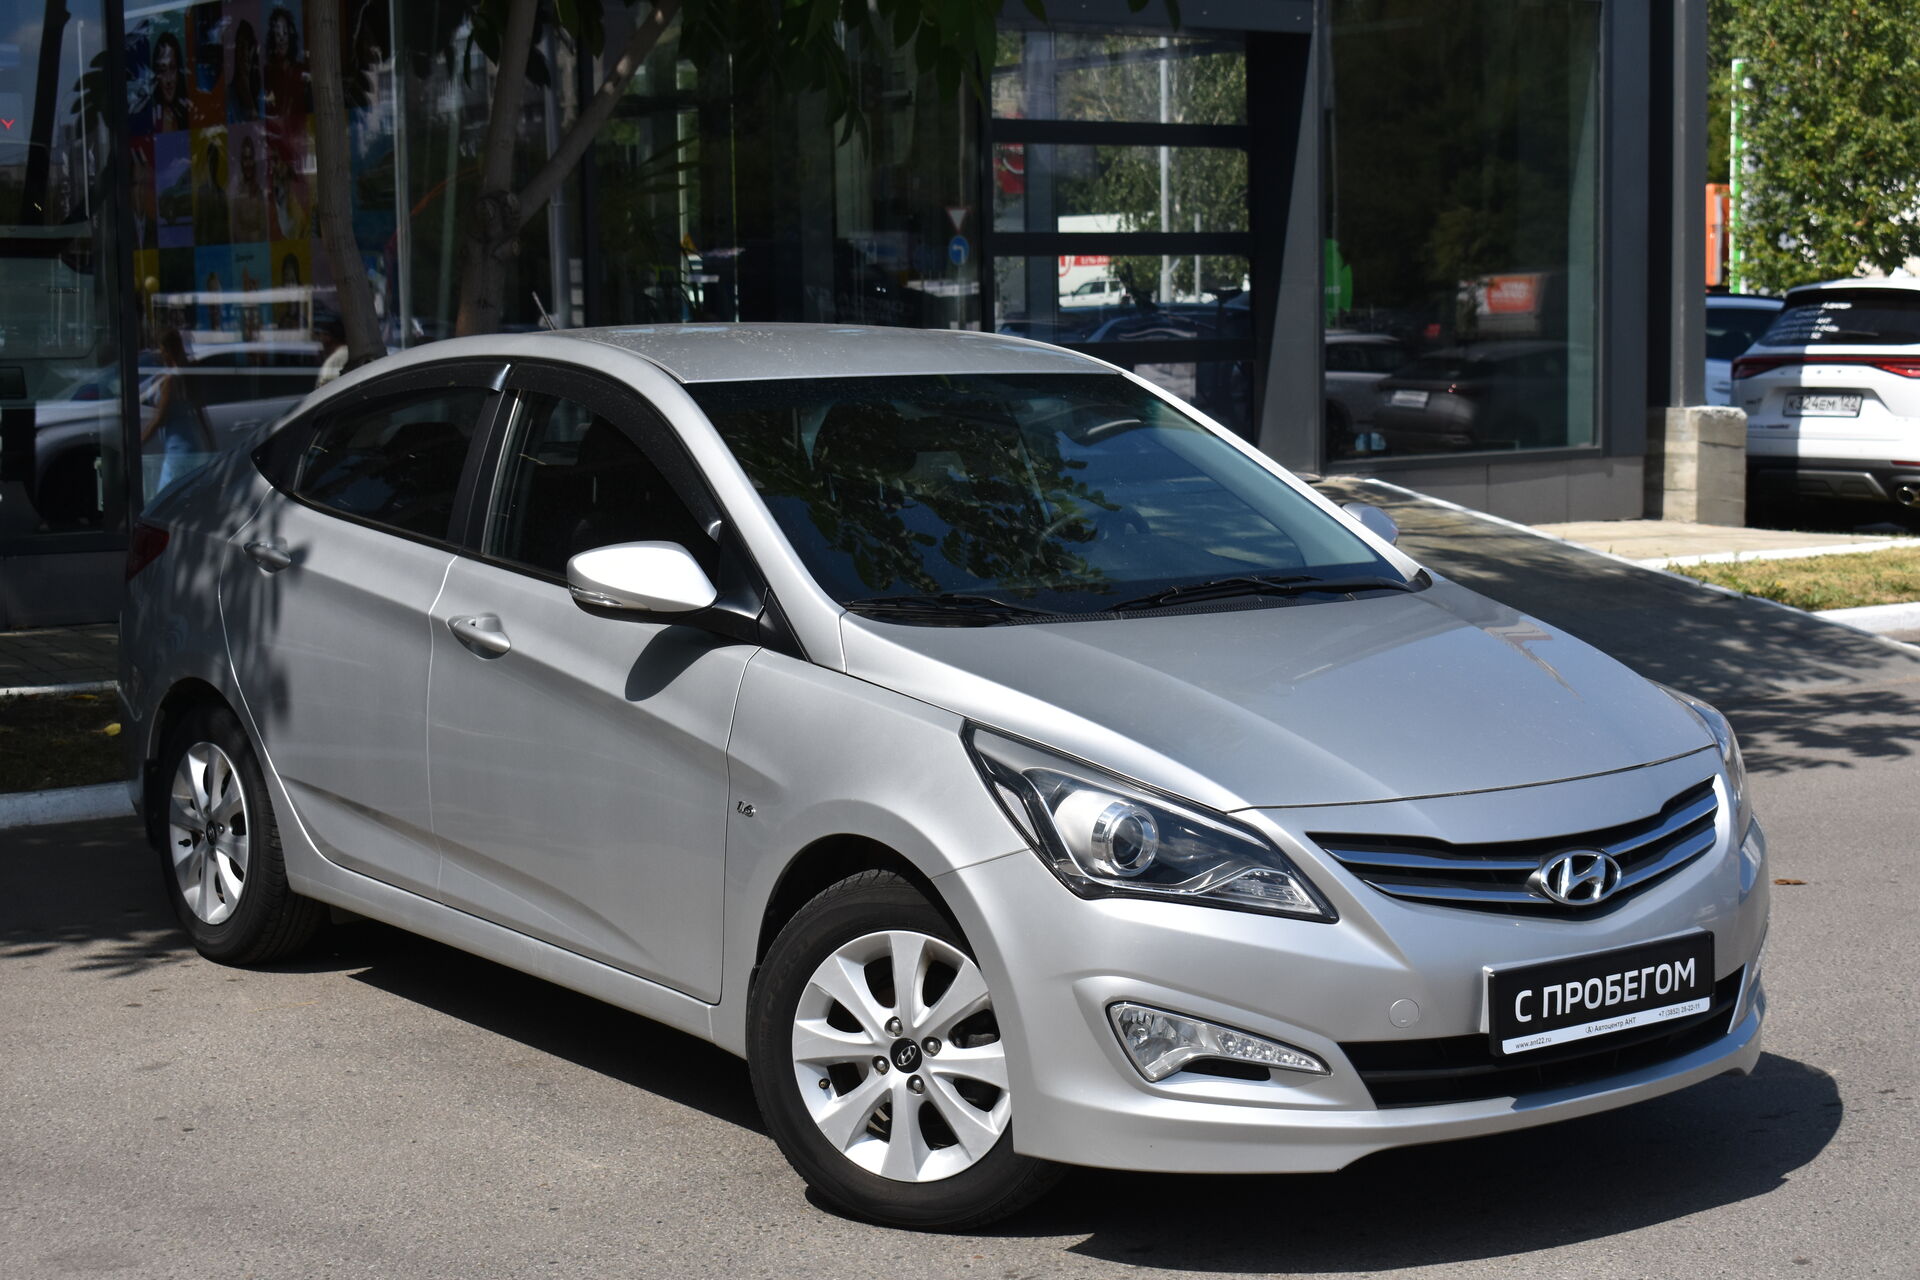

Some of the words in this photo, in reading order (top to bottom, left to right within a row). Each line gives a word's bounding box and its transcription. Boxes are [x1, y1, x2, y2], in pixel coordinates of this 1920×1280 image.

[1514, 990, 1532, 1023] С
[1543, 957, 1696, 1018] ПРОБЕГОМ
[1594, 1020, 1624, 1033] Автоцентр
[1624, 1017, 1637, 1027] АНТ
[1515, 1036, 1552, 1049] www.ant22.ru
